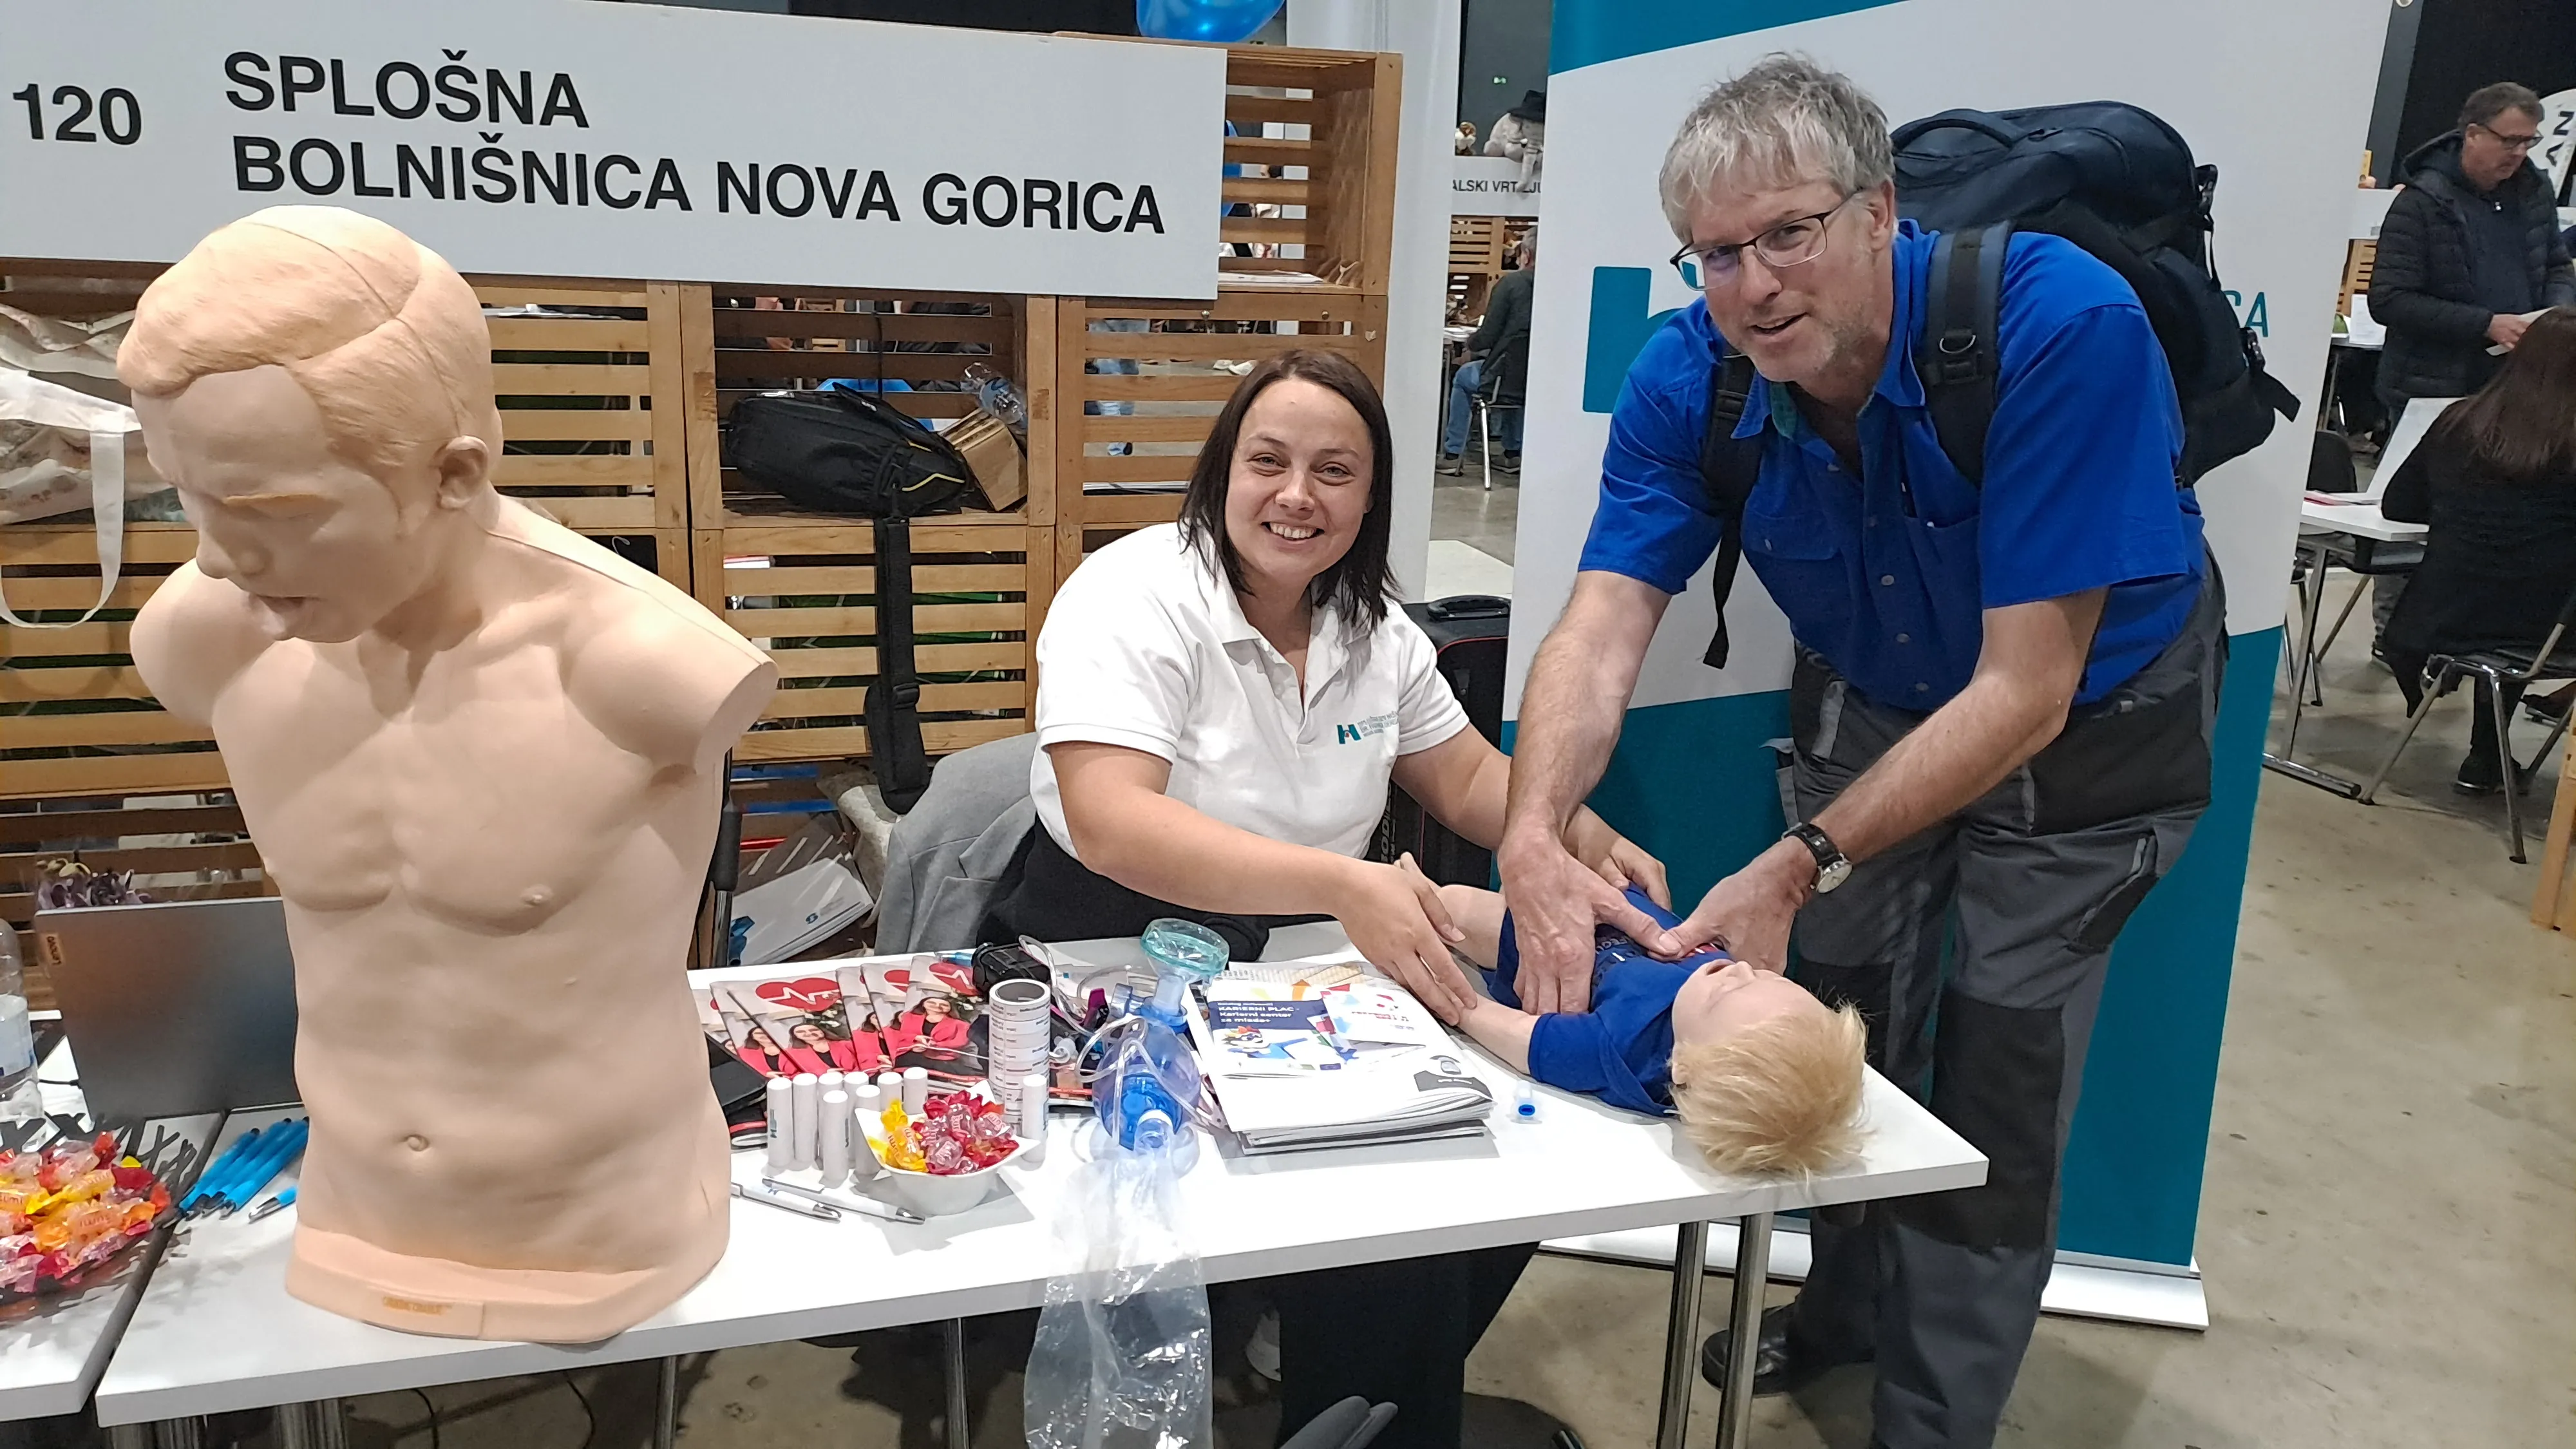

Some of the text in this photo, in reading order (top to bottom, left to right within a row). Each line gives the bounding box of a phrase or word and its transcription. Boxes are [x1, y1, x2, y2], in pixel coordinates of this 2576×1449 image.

[12, 82, 142, 146] 120
[223, 48, 591, 129] SPLOŠNA
[232, 131, 1166, 235] BOLNIŠNICA NOVA GORICA
[1492, 180, 1519, 193] VRT
